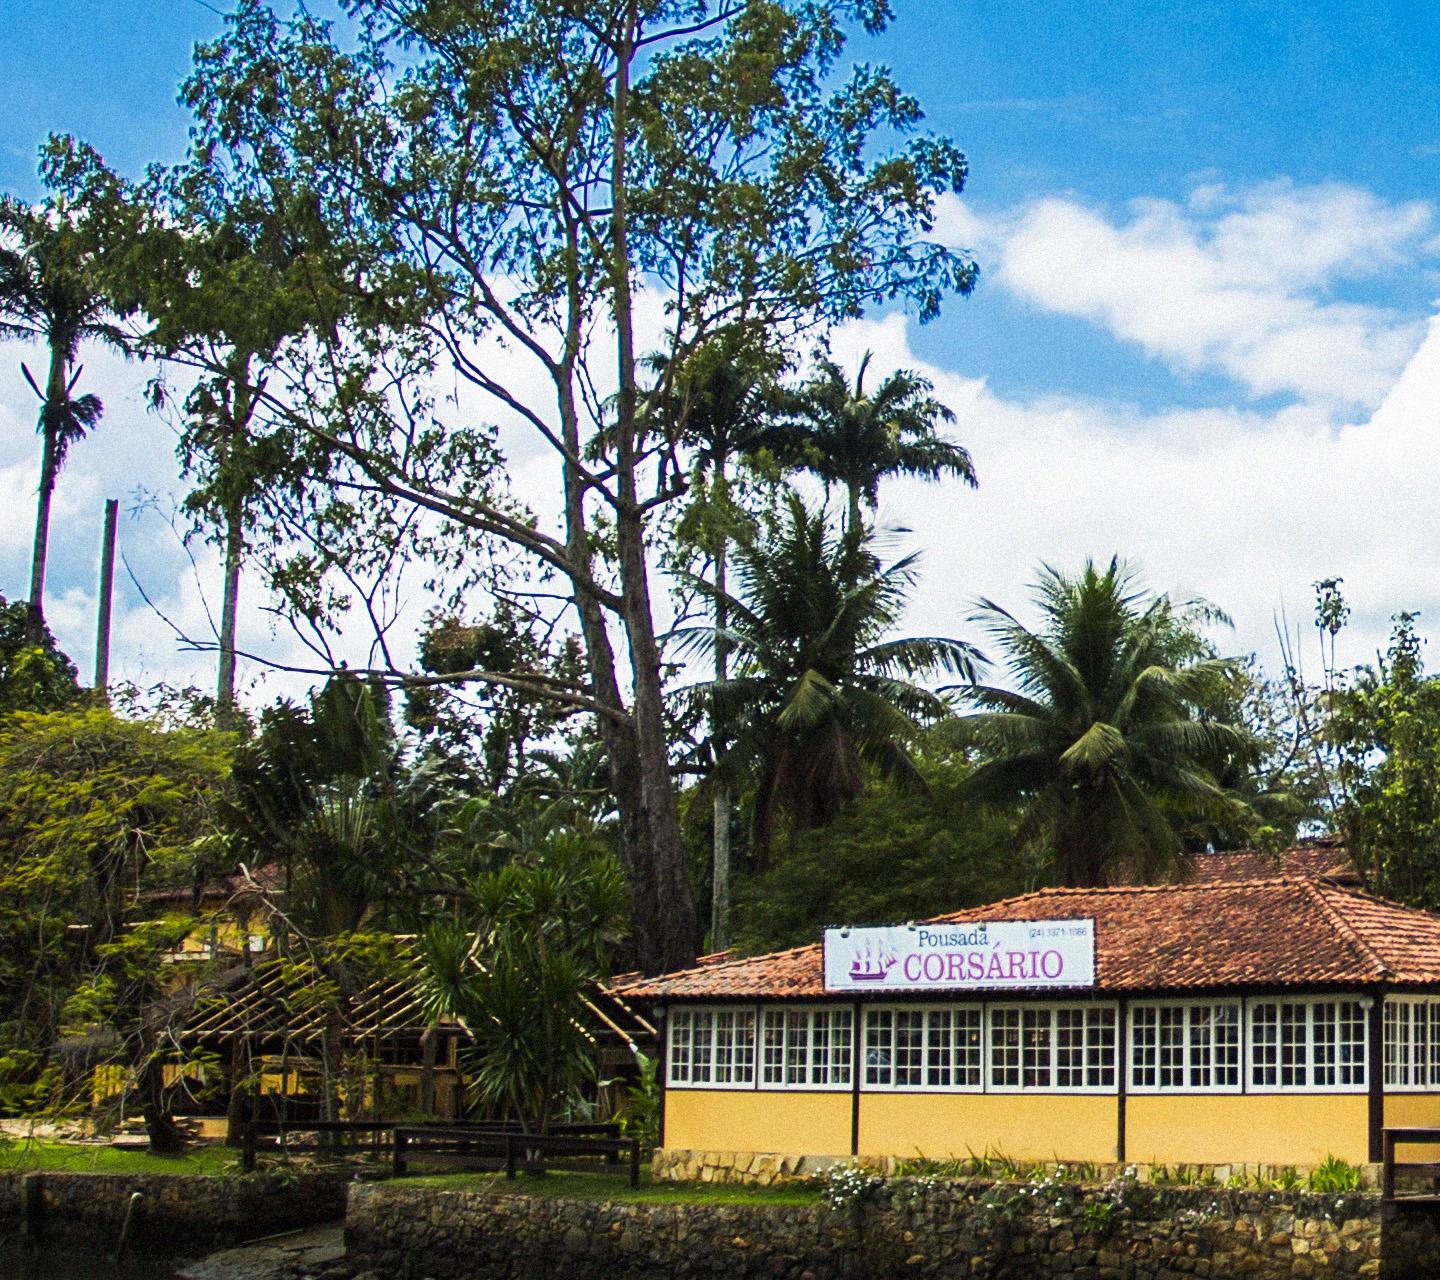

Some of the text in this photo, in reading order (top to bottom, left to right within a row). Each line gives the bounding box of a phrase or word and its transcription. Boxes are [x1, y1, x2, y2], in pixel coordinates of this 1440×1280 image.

[918, 929, 988, 947] Pousada
[1028, 927, 1045, 939] (24)
[903, 941, 1064, 982] CORSÁRIO
